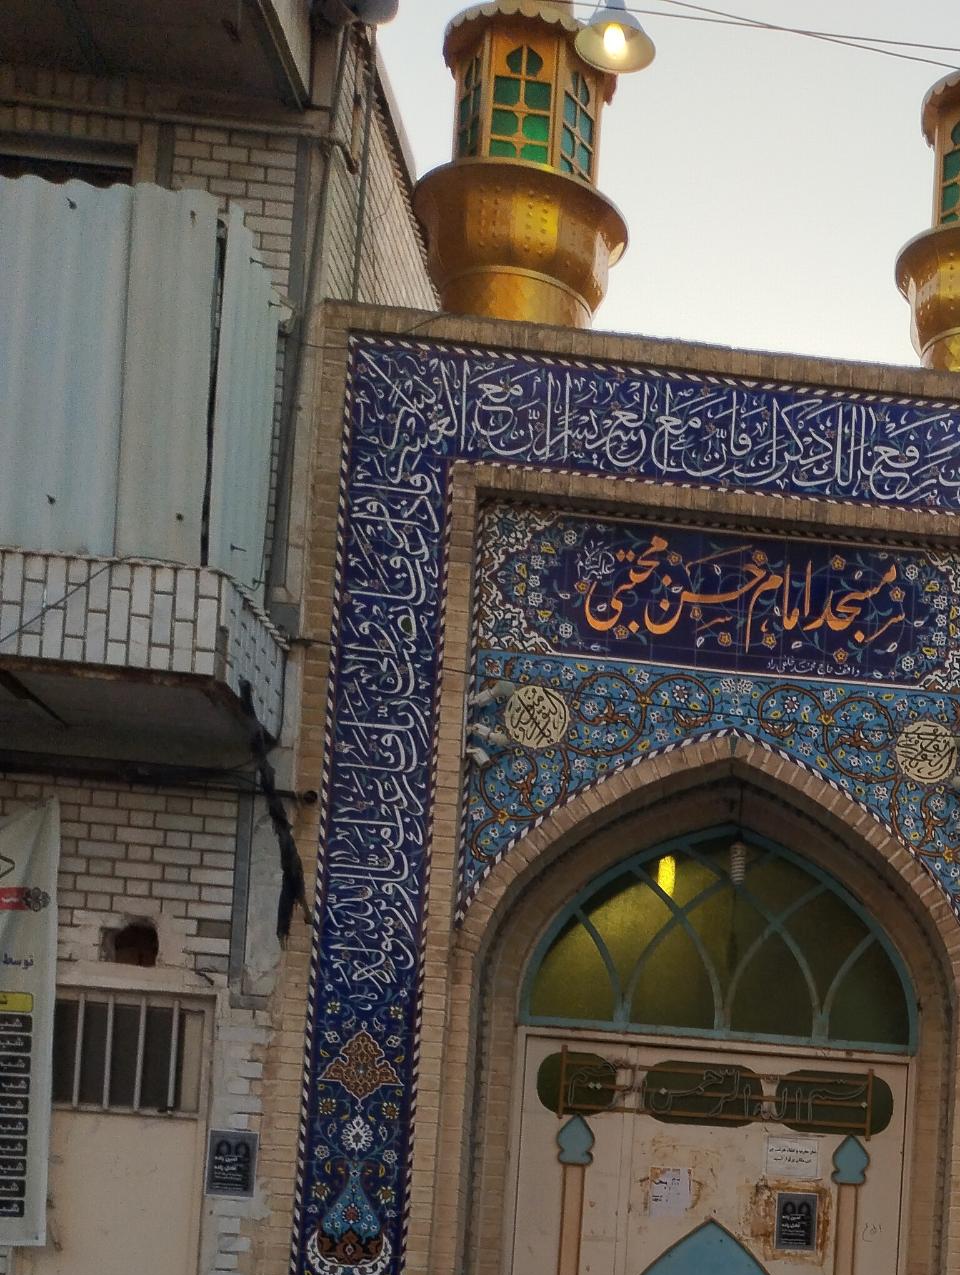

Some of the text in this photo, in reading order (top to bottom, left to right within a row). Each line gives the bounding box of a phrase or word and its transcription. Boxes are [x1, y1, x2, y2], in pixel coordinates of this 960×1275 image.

[644, 560, 764, 635] حسن
[746, 561, 812, 653] امام
[803, 563, 897, 644] مسجد
